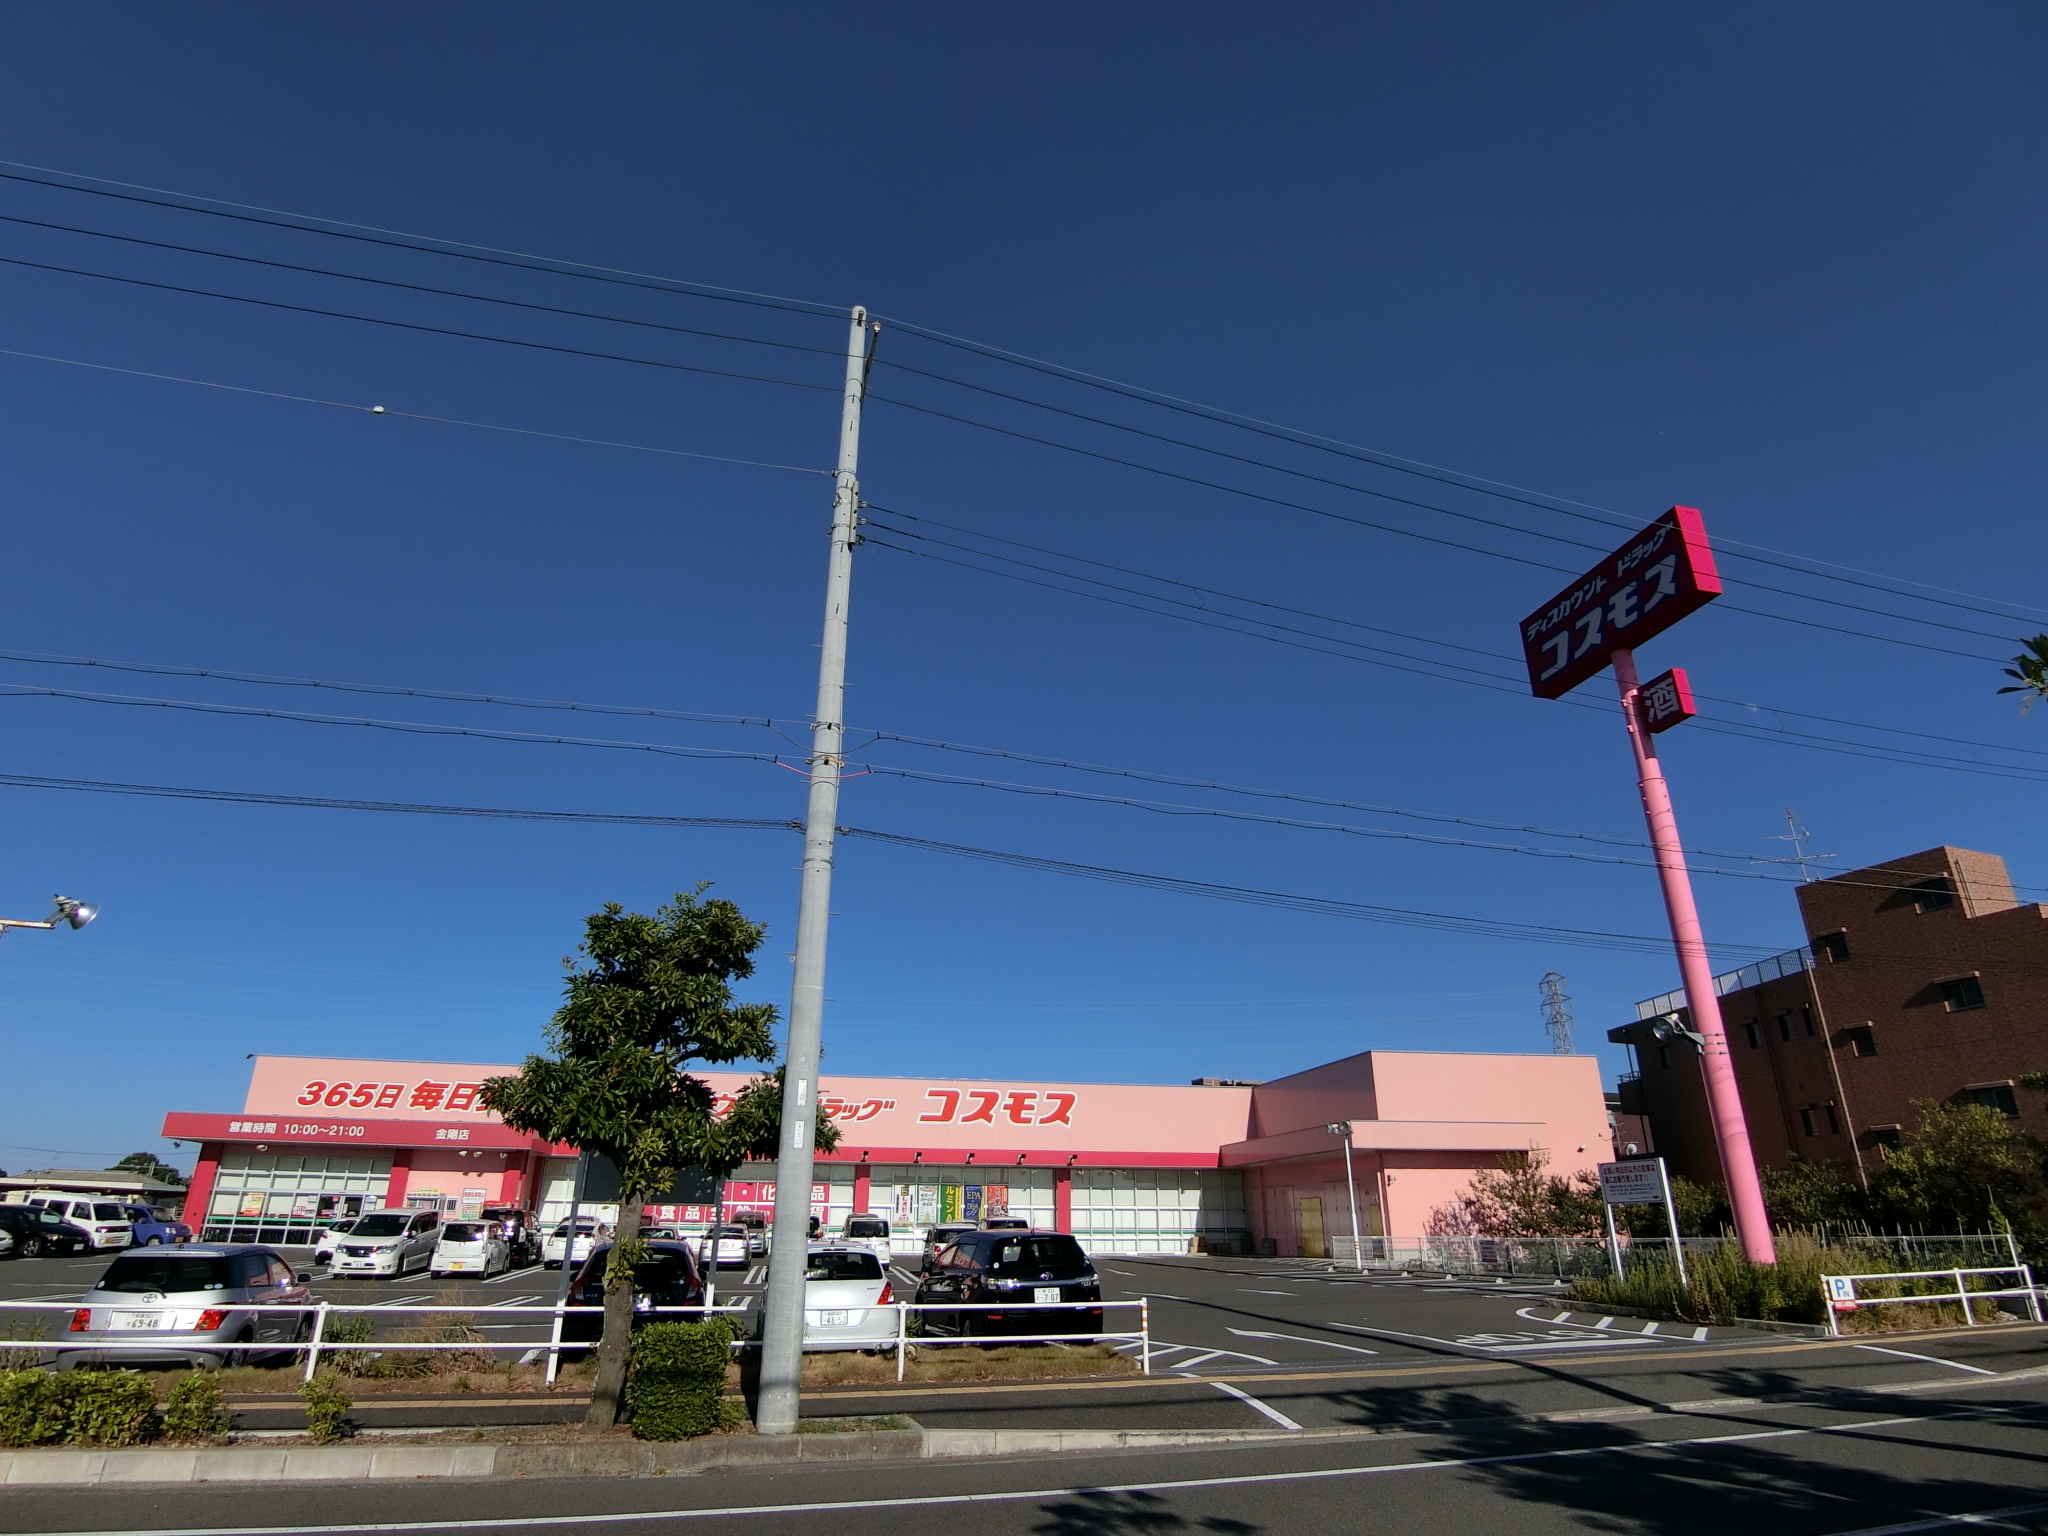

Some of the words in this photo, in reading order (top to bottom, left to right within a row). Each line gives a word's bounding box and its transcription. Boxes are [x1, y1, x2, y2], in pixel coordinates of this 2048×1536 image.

[1527, 576, 1607, 642] ディスカウント
[1617, 520, 1675, 577] ドラッグ
[1540, 554, 1677, 682] コスモス
[1642, 676, 1680, 723] 酒
[298, 1081, 405, 1109] 365日
[815, 1097, 895, 1121] ラッグ
[917, 1089, 1078, 1127] コスモス
[229, 1121, 276, 1135] 営業時間
[436, 1128, 470, 1141] 金剛店
[967, 1191, 981, 1200] EPA
[1834, 1279, 1845, 1297] P
[131, 1319, 158, 1327] 69-48
